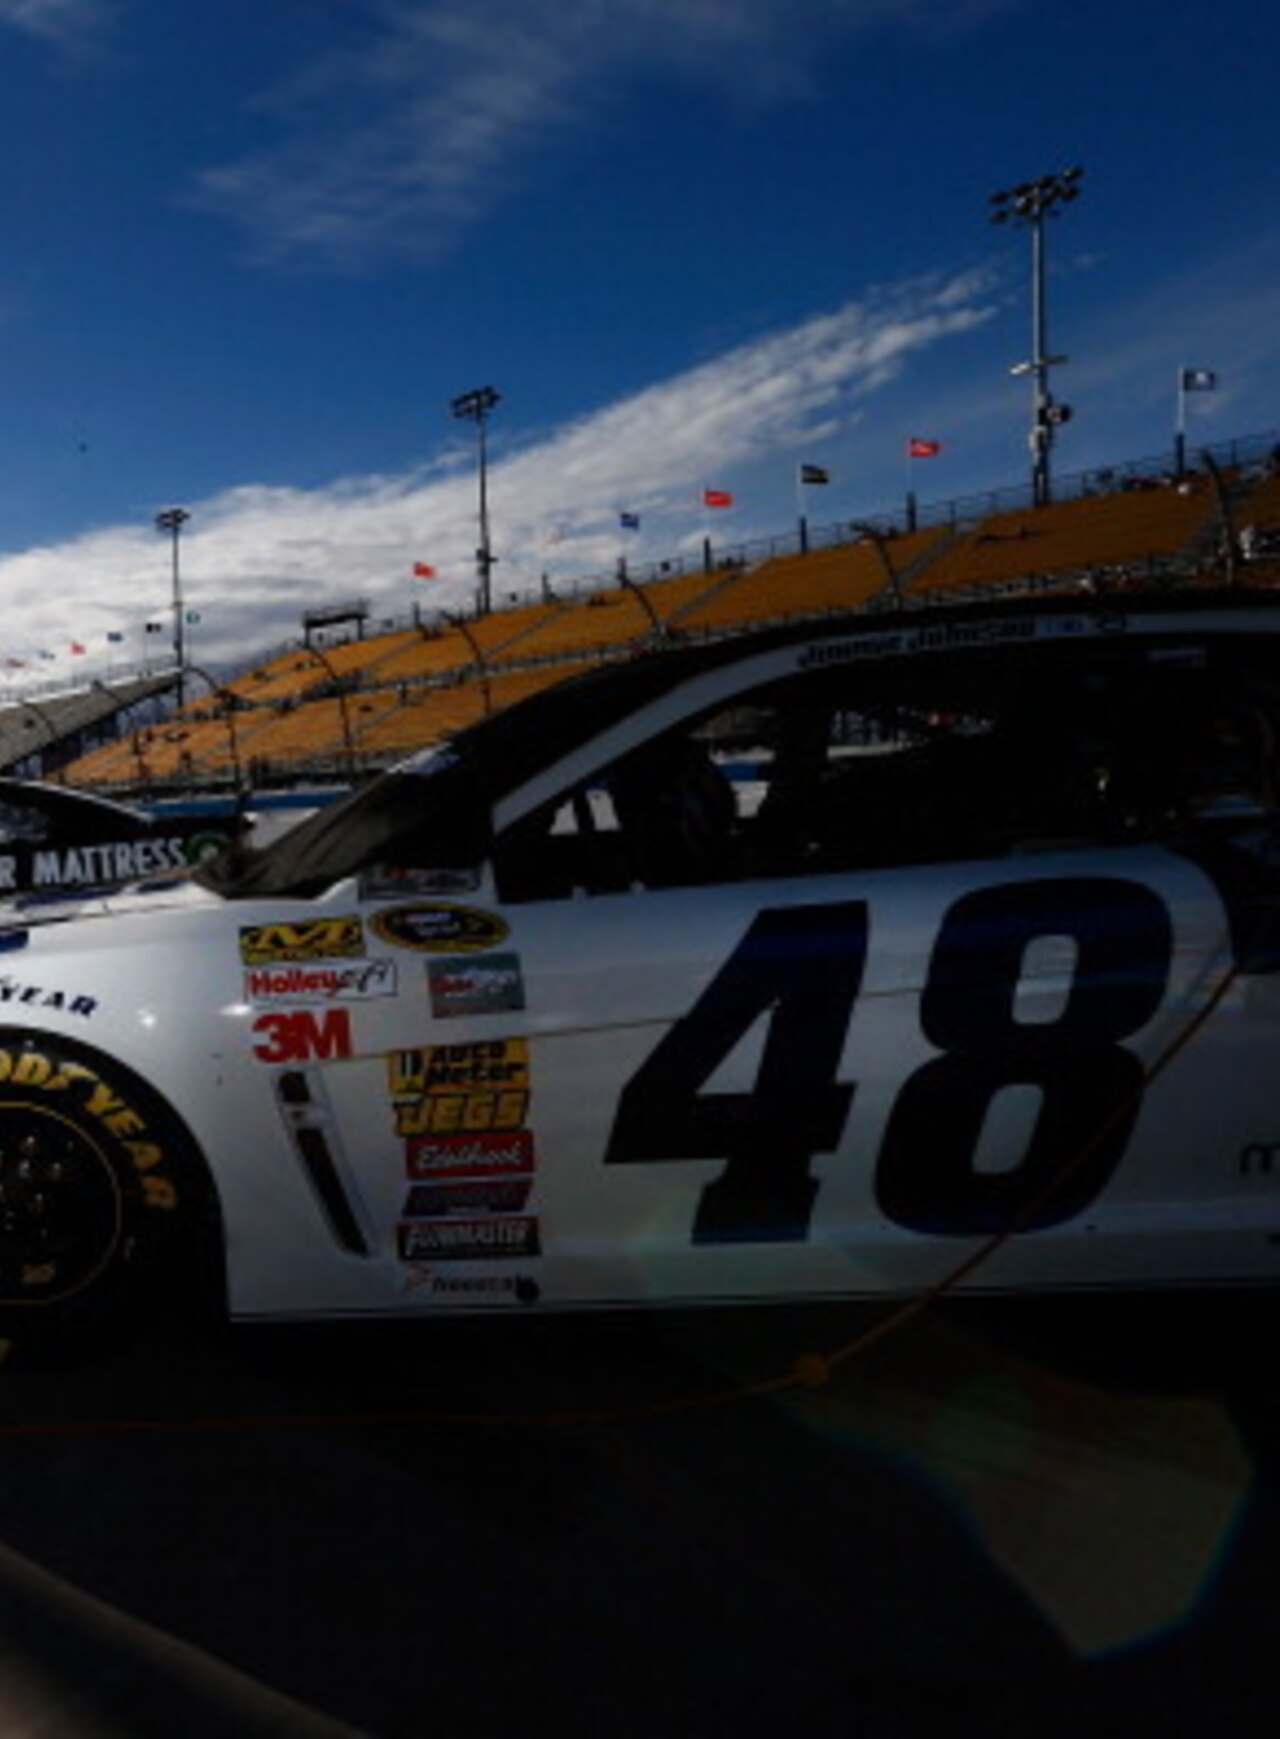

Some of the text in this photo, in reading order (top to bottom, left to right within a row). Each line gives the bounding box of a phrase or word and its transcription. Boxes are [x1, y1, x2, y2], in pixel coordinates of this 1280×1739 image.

[31, 837, 188, 886] MATTRESS
[249, 966, 340, 998] Holley
[252, 1007, 354, 1065] 3M
[606, 877, 1172, 1244] 48
